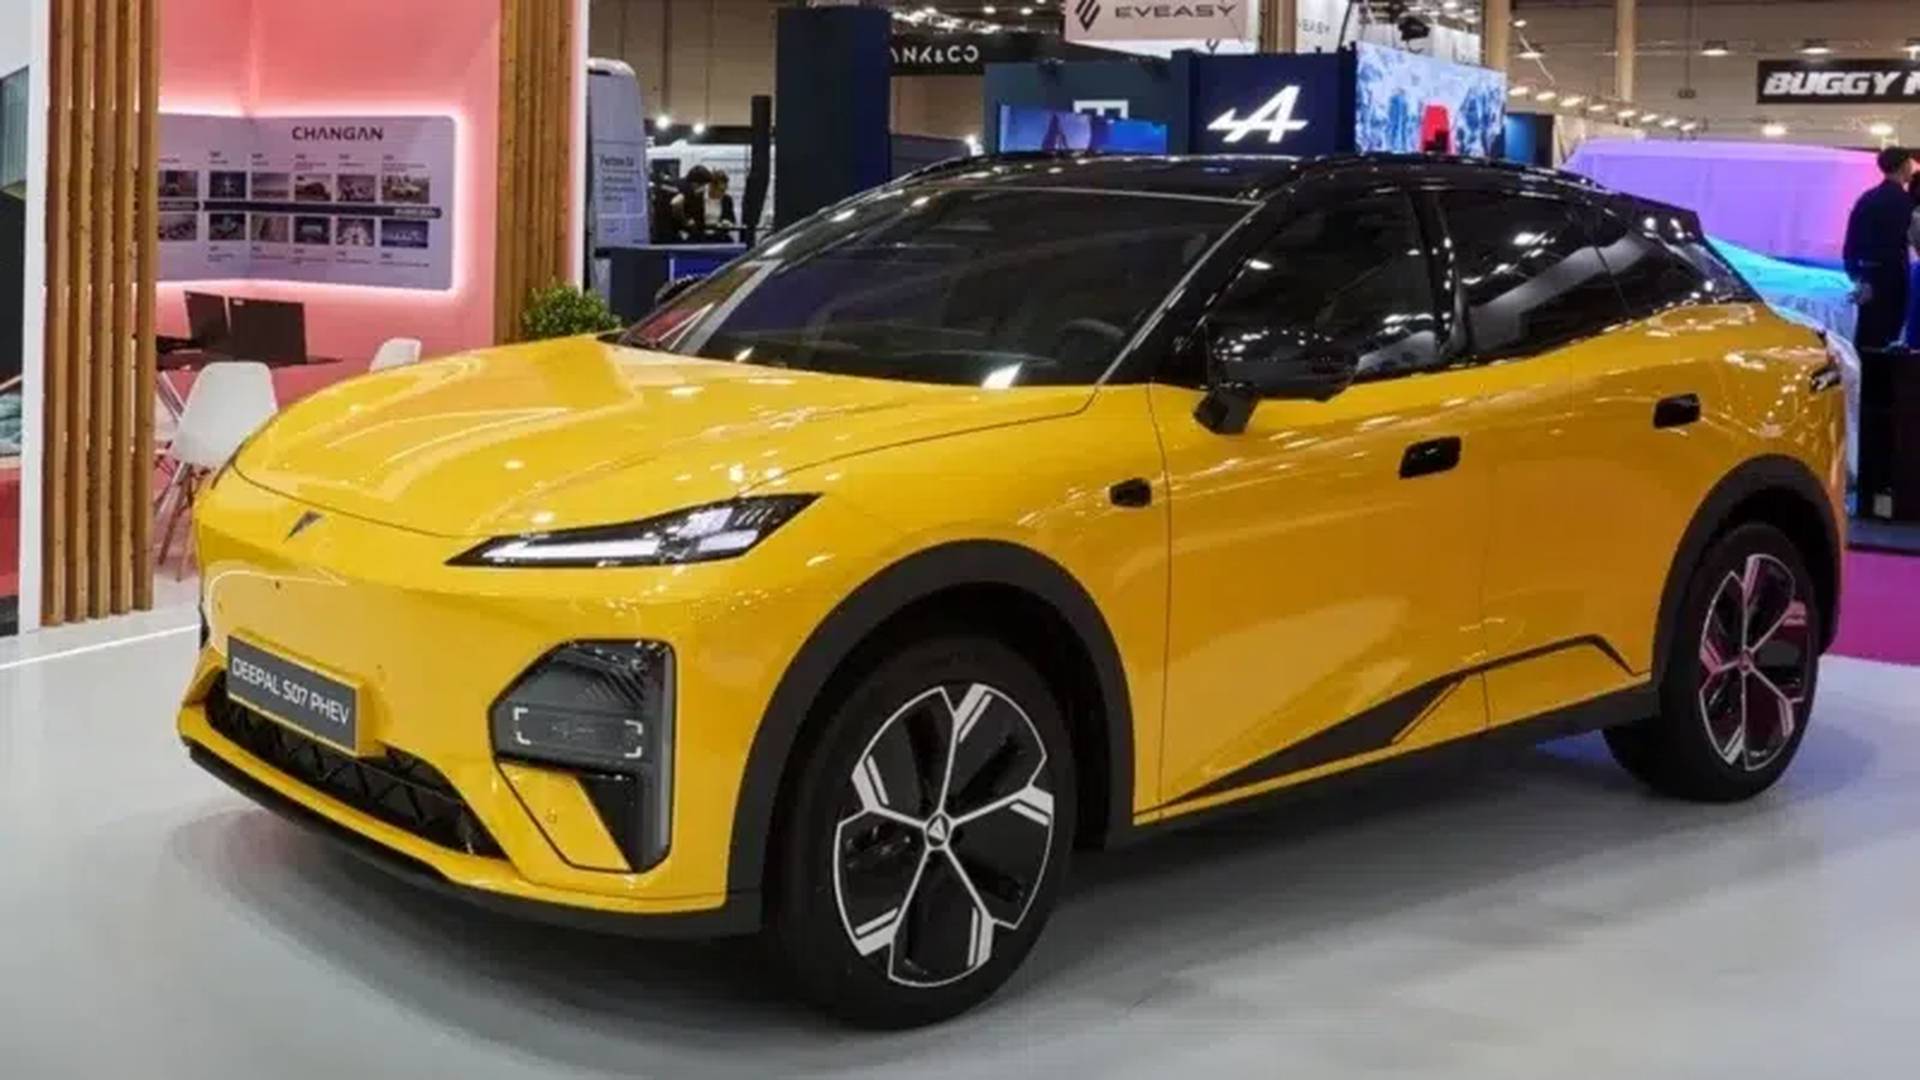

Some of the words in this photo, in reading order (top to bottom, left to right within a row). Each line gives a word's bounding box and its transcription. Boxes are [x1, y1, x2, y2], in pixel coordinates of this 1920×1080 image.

[1115, 4, 1237, 18] EVEASY
[1762, 71, 1901, 95] BUGGY
[291, 126, 384, 141] CHANGAN
[232, 657, 281, 695] DEEPAL
[310, 692, 350, 725] PHEV
